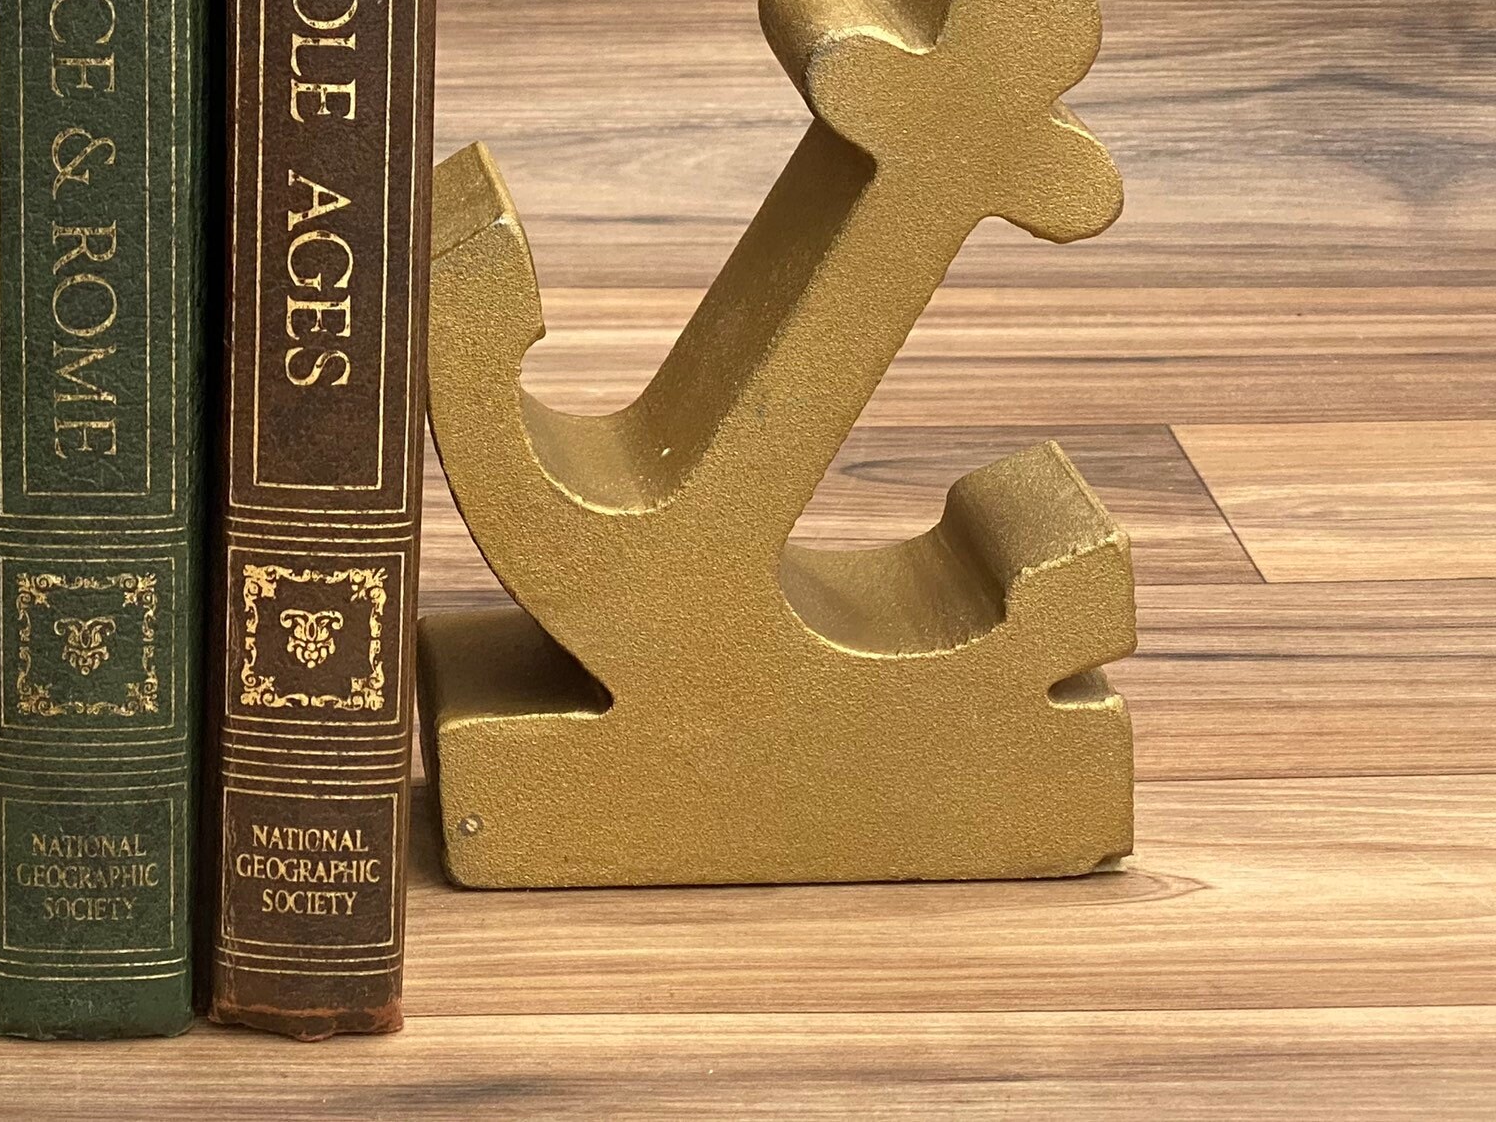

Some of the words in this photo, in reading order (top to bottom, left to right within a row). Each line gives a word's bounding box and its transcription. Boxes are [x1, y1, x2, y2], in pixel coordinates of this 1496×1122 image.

[49, 127, 117, 200] &
[285, 167, 354, 388] AGES
[50, 220, 117, 460] ROME
[31, 833, 147, 858] NATIONAL
[251, 824, 369, 852] NATIONAL
[16, 862, 160, 888] GEOGRAPHIC
[235, 852, 381, 884] GEOGRAPHIC
[41, 896, 136, 921] SOCIETY
[261, 888, 358, 915] SOCIETY
